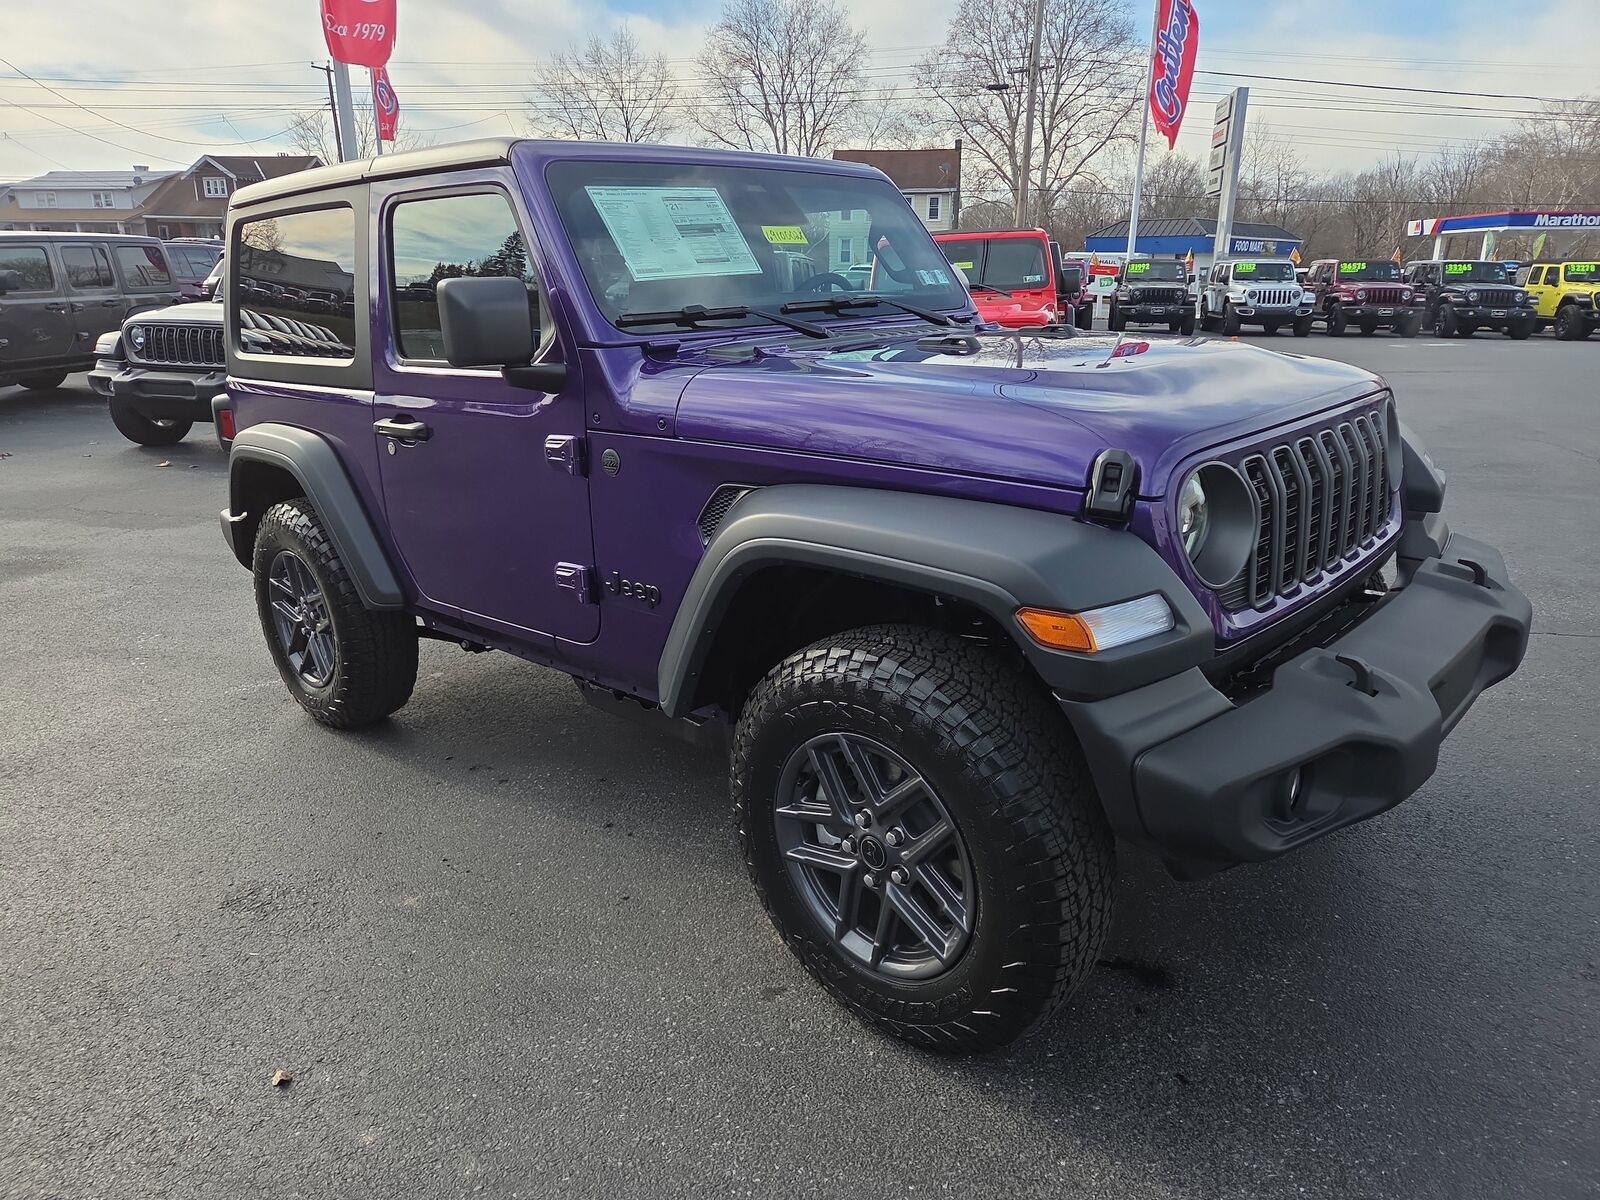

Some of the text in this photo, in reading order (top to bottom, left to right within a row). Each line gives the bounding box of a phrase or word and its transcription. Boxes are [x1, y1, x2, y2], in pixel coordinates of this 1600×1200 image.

[353, 22, 385, 41] 1979
[1234, 240, 1249, 252] FOOD
[605, 571, 661, 608] Jeep
